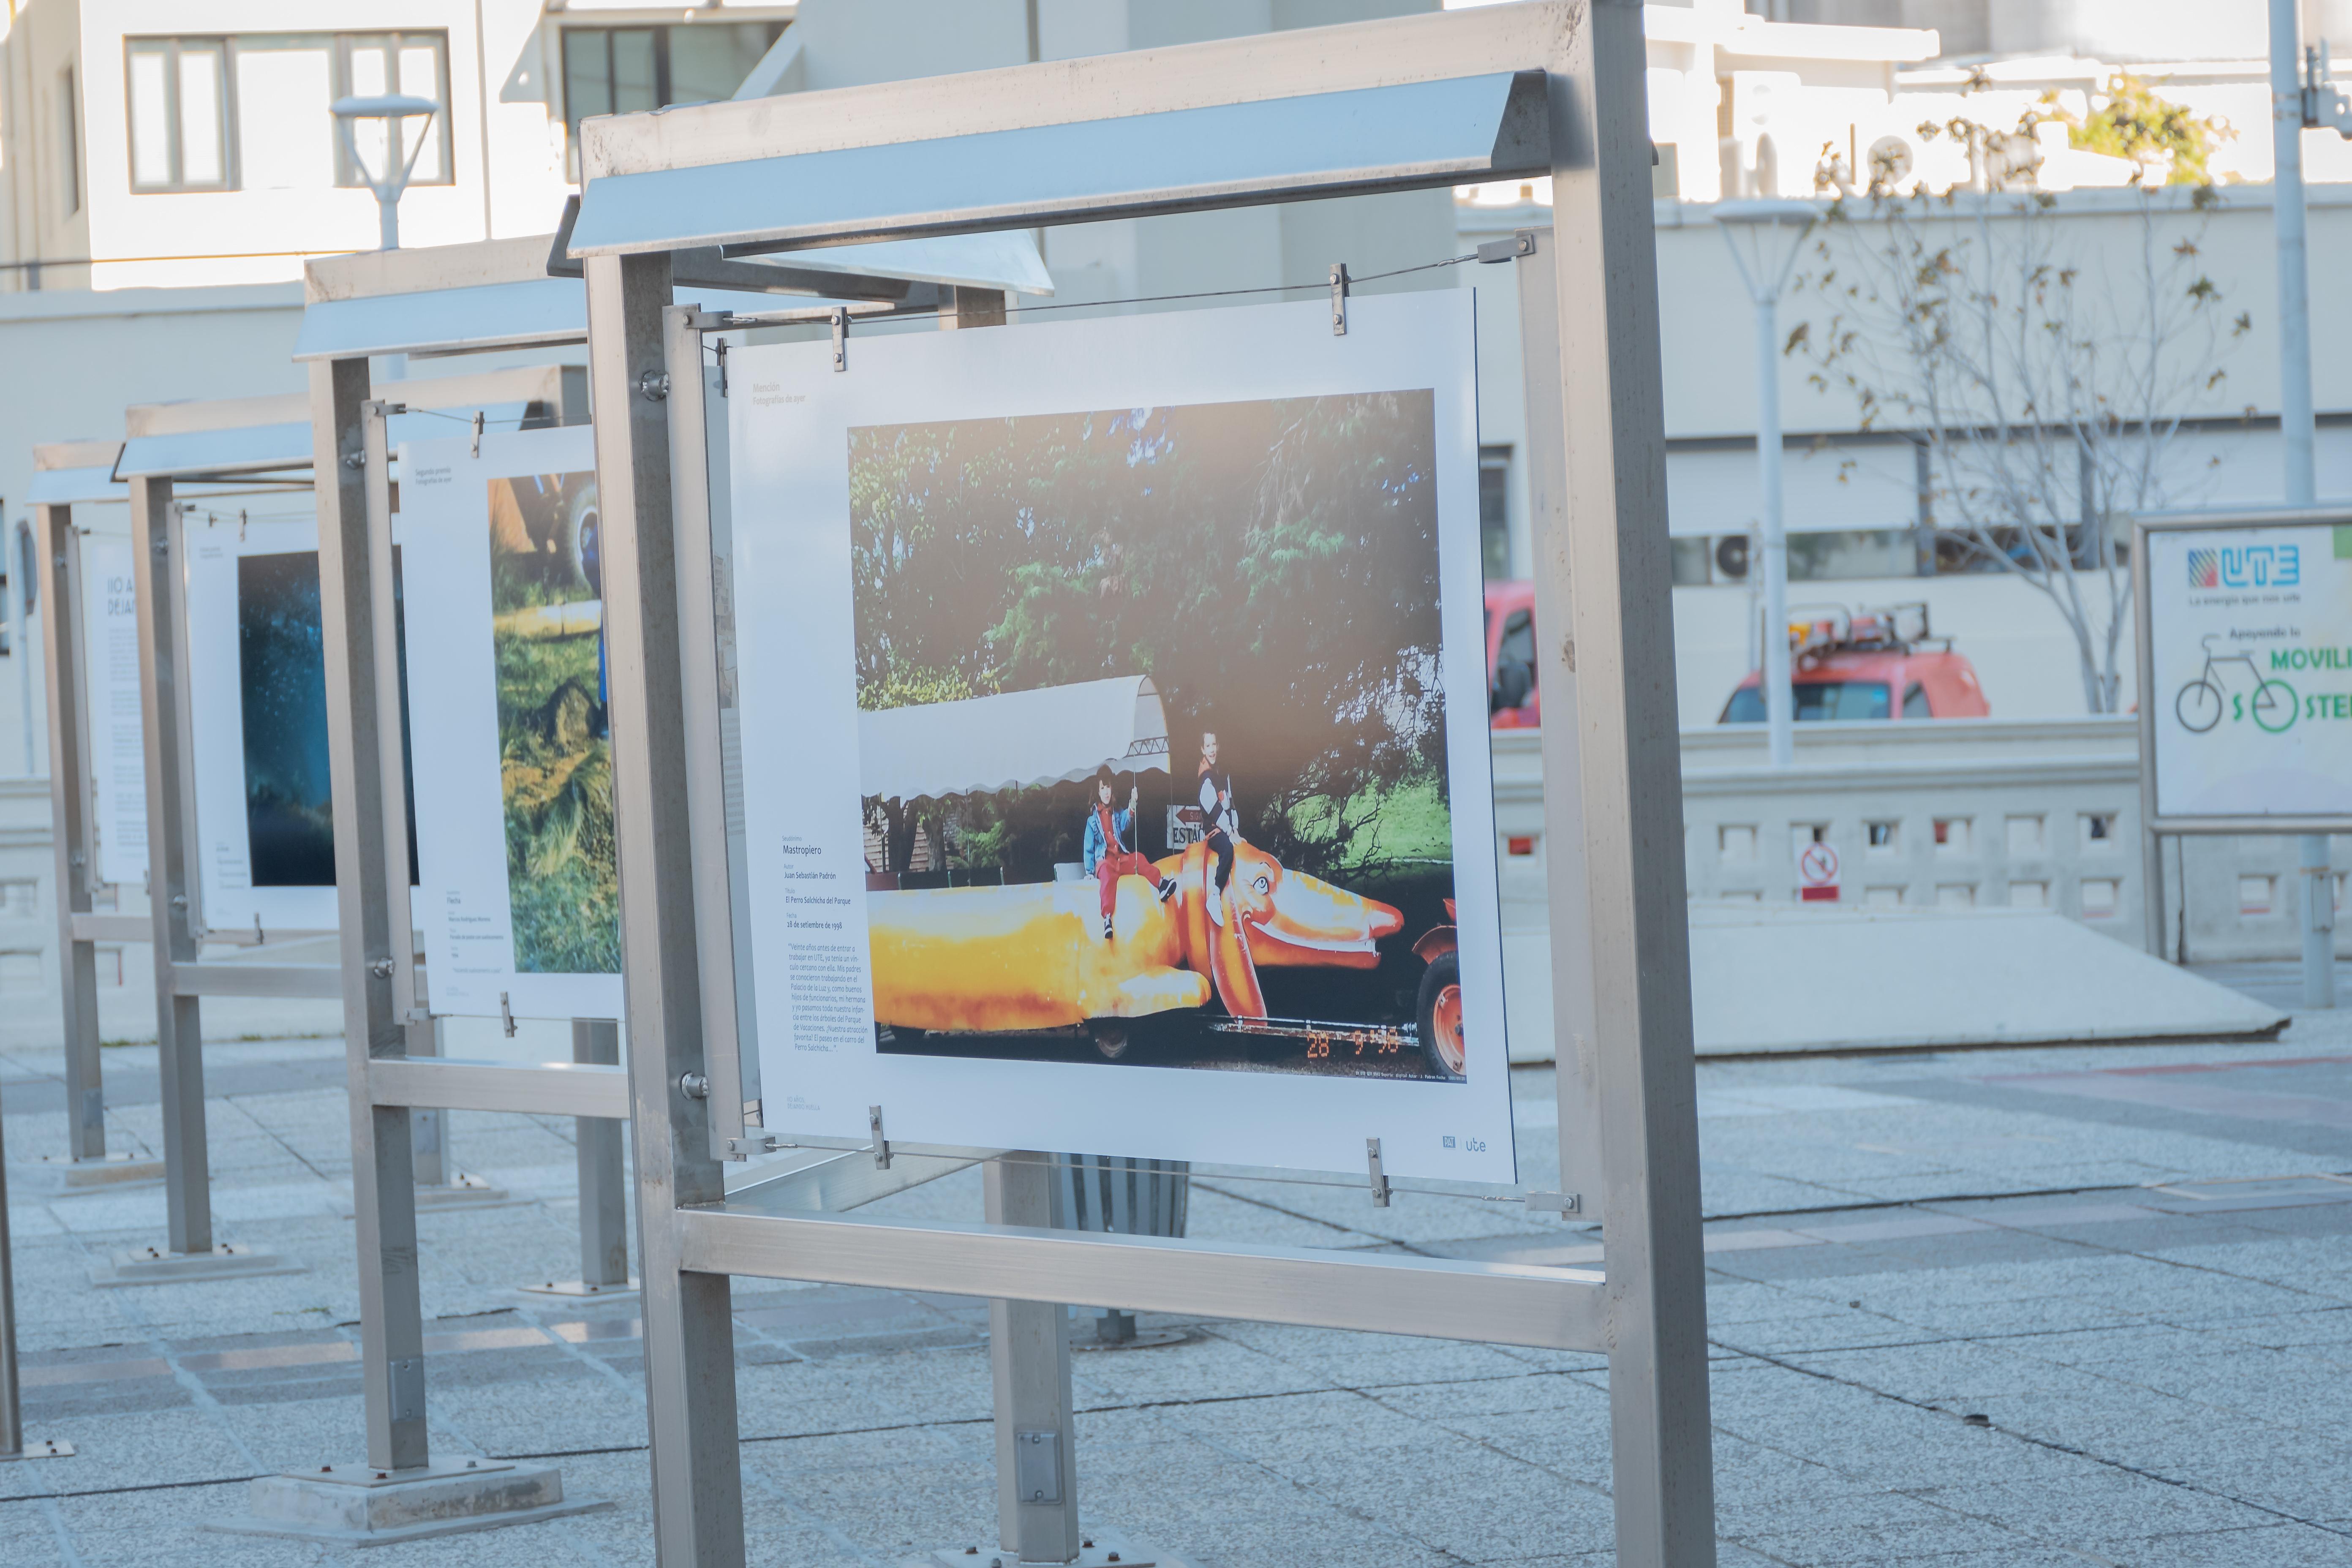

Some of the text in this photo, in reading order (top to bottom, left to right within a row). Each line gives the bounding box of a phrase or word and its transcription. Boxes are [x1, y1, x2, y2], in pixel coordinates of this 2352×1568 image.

[753, 382, 780, 392] Mención
[753, 394, 806, 406] Fotografías de ayer
[108, 598, 134, 616] DEJA
[783, 845, 822, 857] Mastropiero
[834, 897, 851, 906] Parque
[832, 922, 842, 931] 1998
[789, 953, 807, 962] trabajar
[814, 954, 824, 962] UTE,
[846, 965, 861, 973] padres
[821, 975, 846, 983] trabajando
[845, 985, 862, 993] buenos
[791, 993, 802, 1002] hijos
[809, 993, 838, 1003] funcionarios,
[845, 995, 866, 1003] hermana
[820, 1014, 836, 1022] árboles
[845, 1015, 861, 1024] Parque
[826, 1025, 846, 1033] ¿Nuestra
[794, 1033, 813, 1042] favorita?
[1307, 1032, 1329, 1058] 28
[1444, 1137, 1486, 1152] PAT ute
